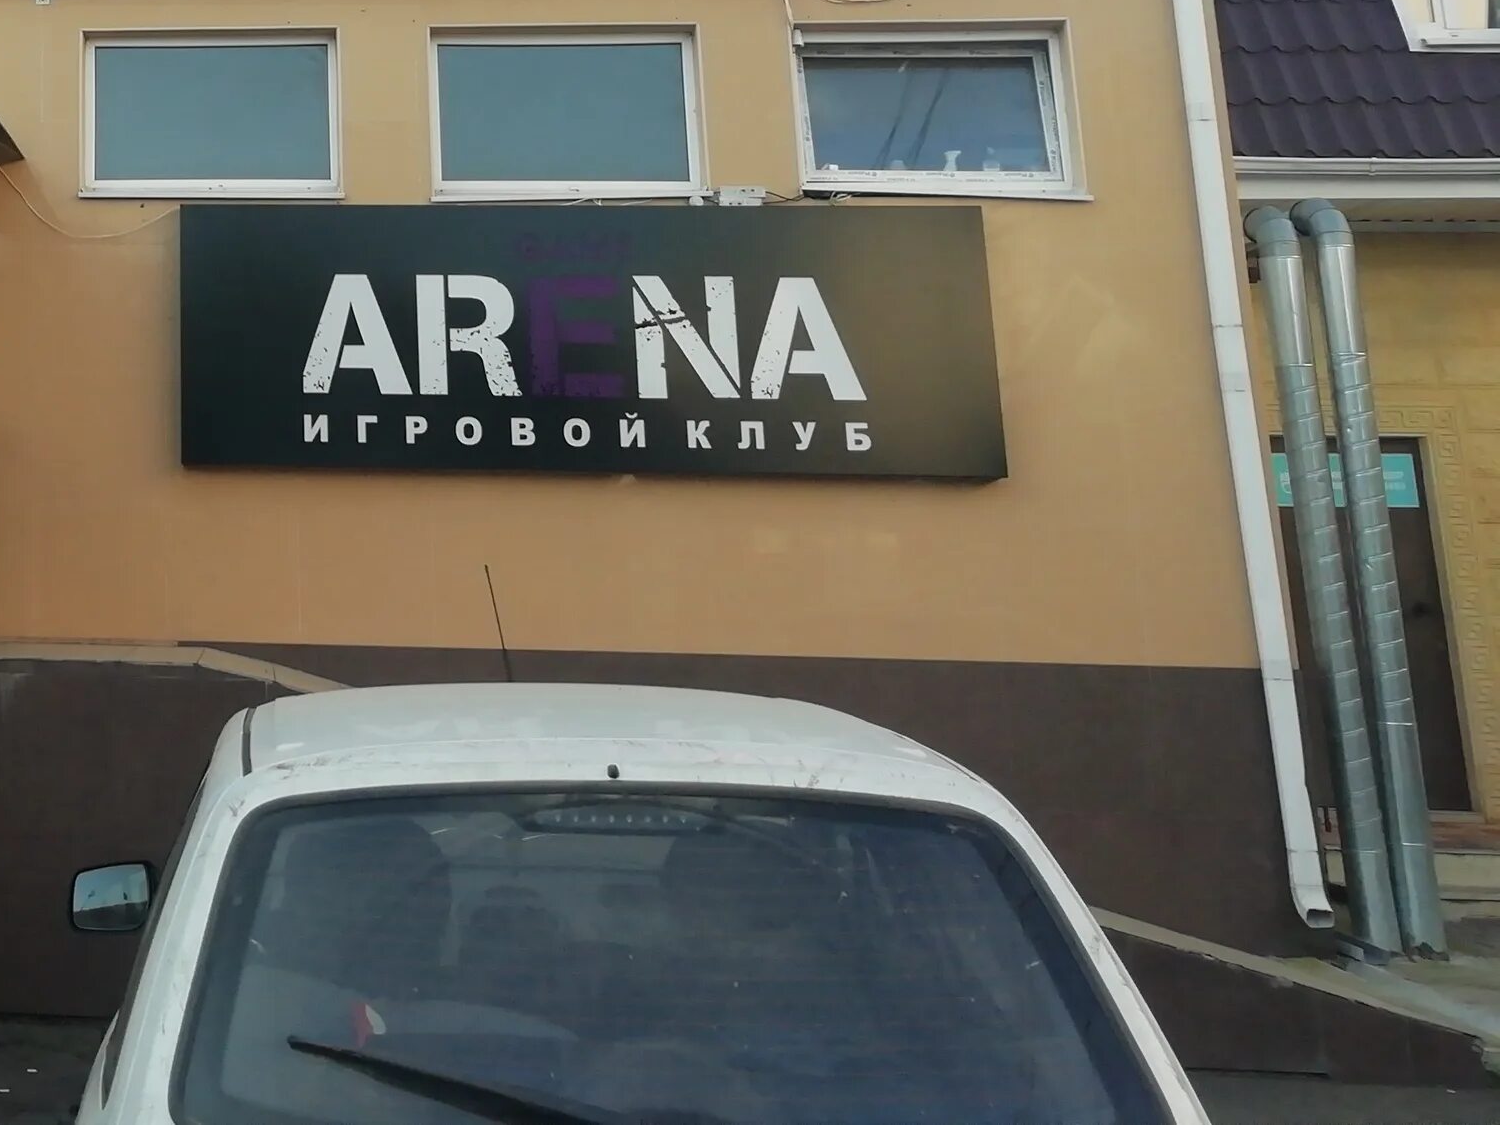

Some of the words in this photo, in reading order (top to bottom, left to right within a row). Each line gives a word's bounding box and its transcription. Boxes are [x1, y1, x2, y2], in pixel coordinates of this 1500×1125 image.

[302, 274, 868, 401] ARENA
[303, 412, 647, 450] ИГРОВОЙ
[686, 419, 873, 452] КЛУБ
